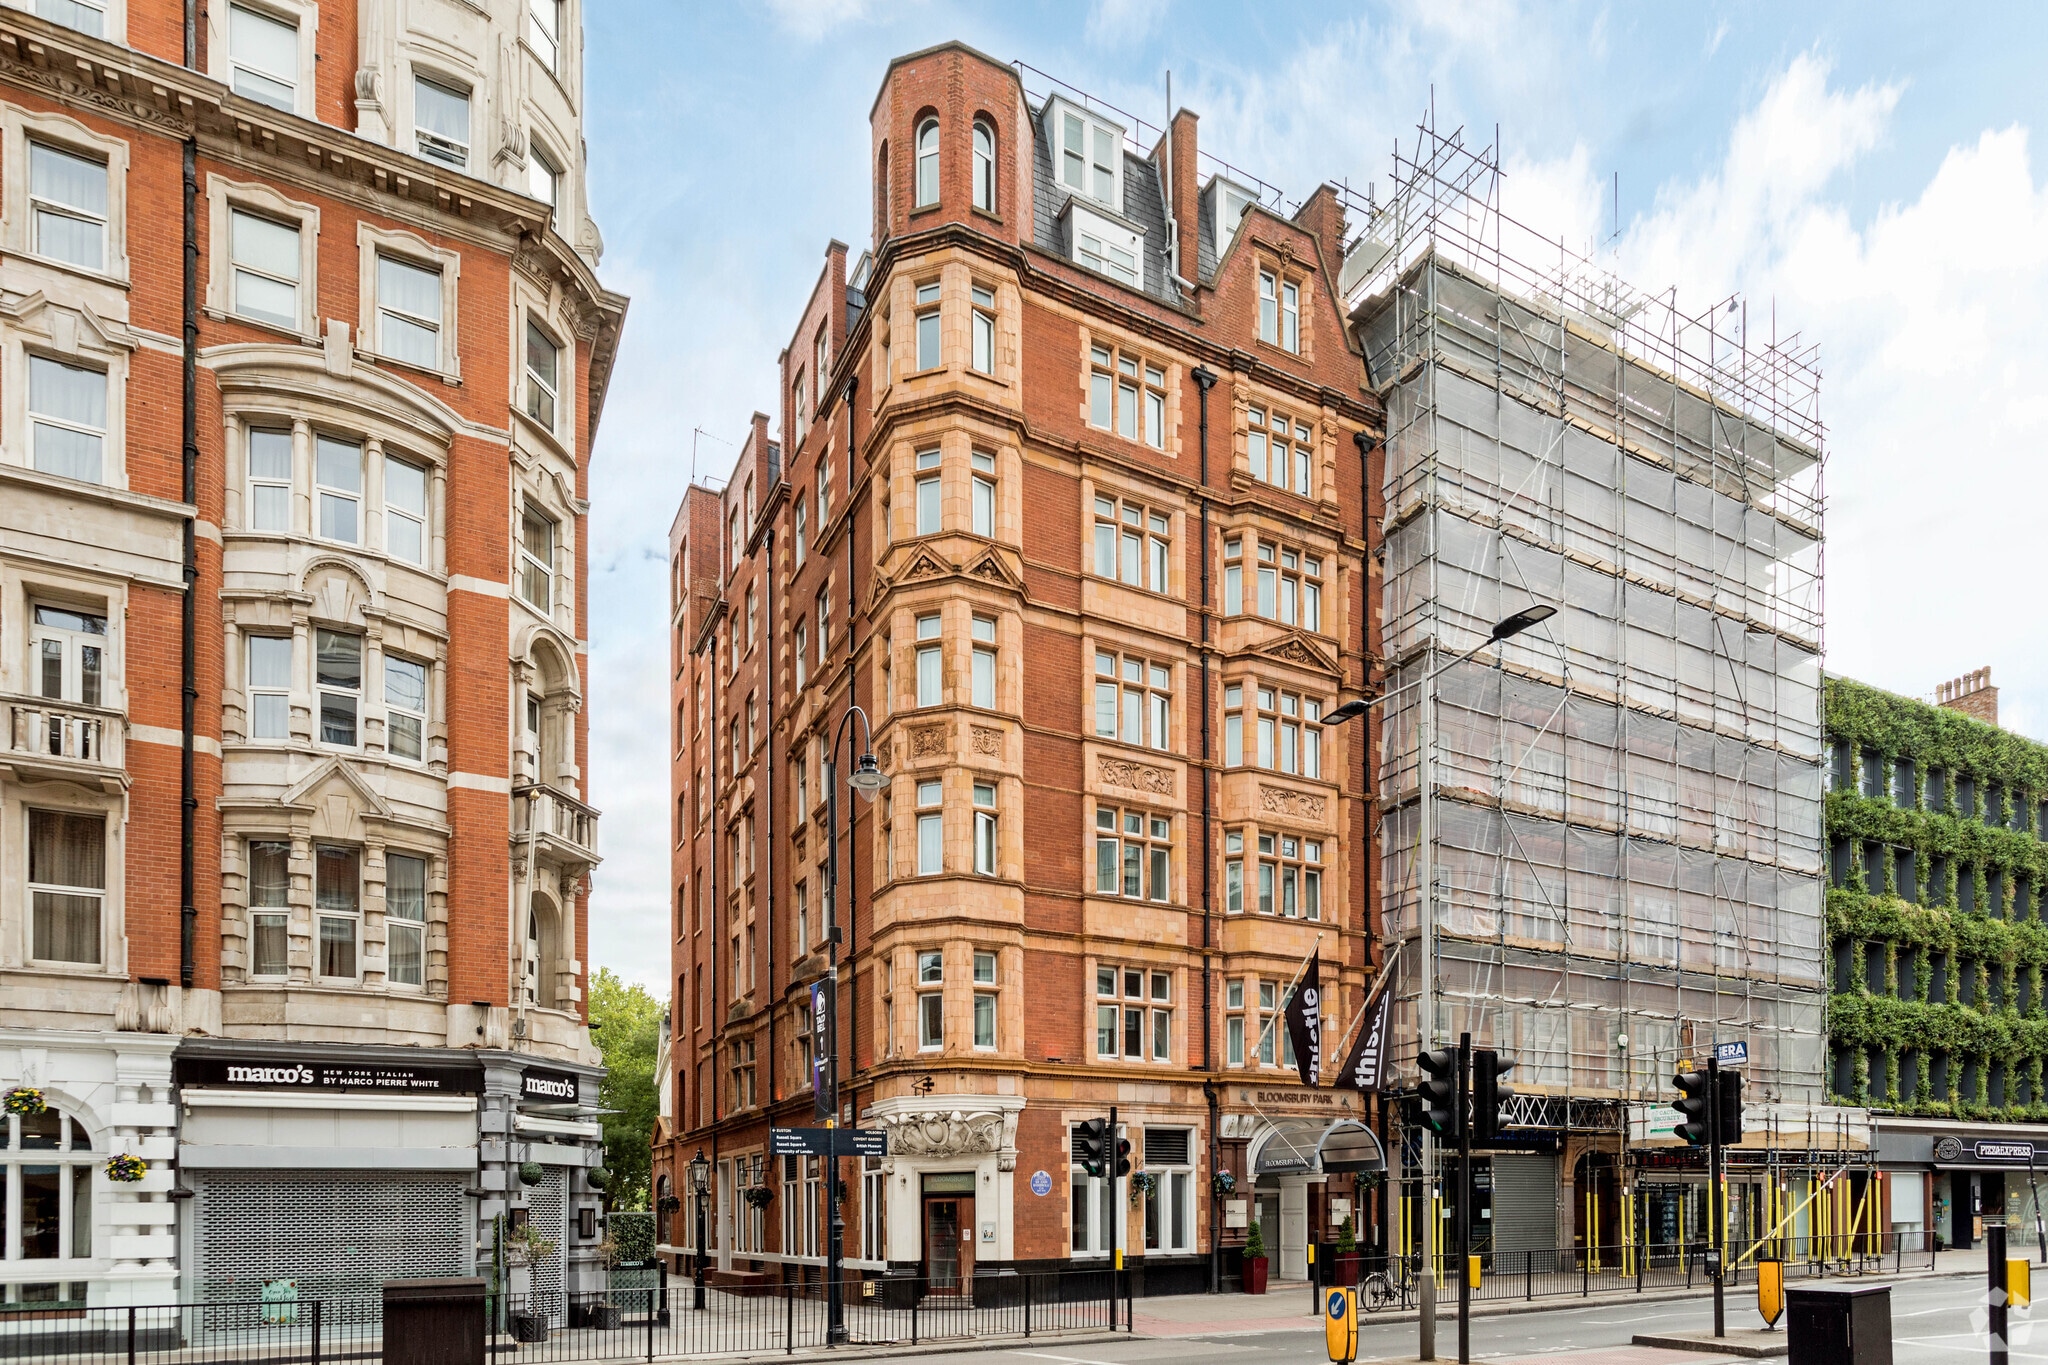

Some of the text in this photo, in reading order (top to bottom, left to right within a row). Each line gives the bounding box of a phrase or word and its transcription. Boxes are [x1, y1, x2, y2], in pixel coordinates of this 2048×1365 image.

[1721, 1043, 1745, 1056] ERA
[227, 1064, 314, 1084] marco's
[323, 1077, 440, 1088] BY MARCO PIERRE WHITE
[526, 1077, 575, 1098] marco's
[1257, 1091, 1333, 1104] BLOOMSBURY PARK
[1265, 1159, 1294, 1167] BLOOMSBURY
